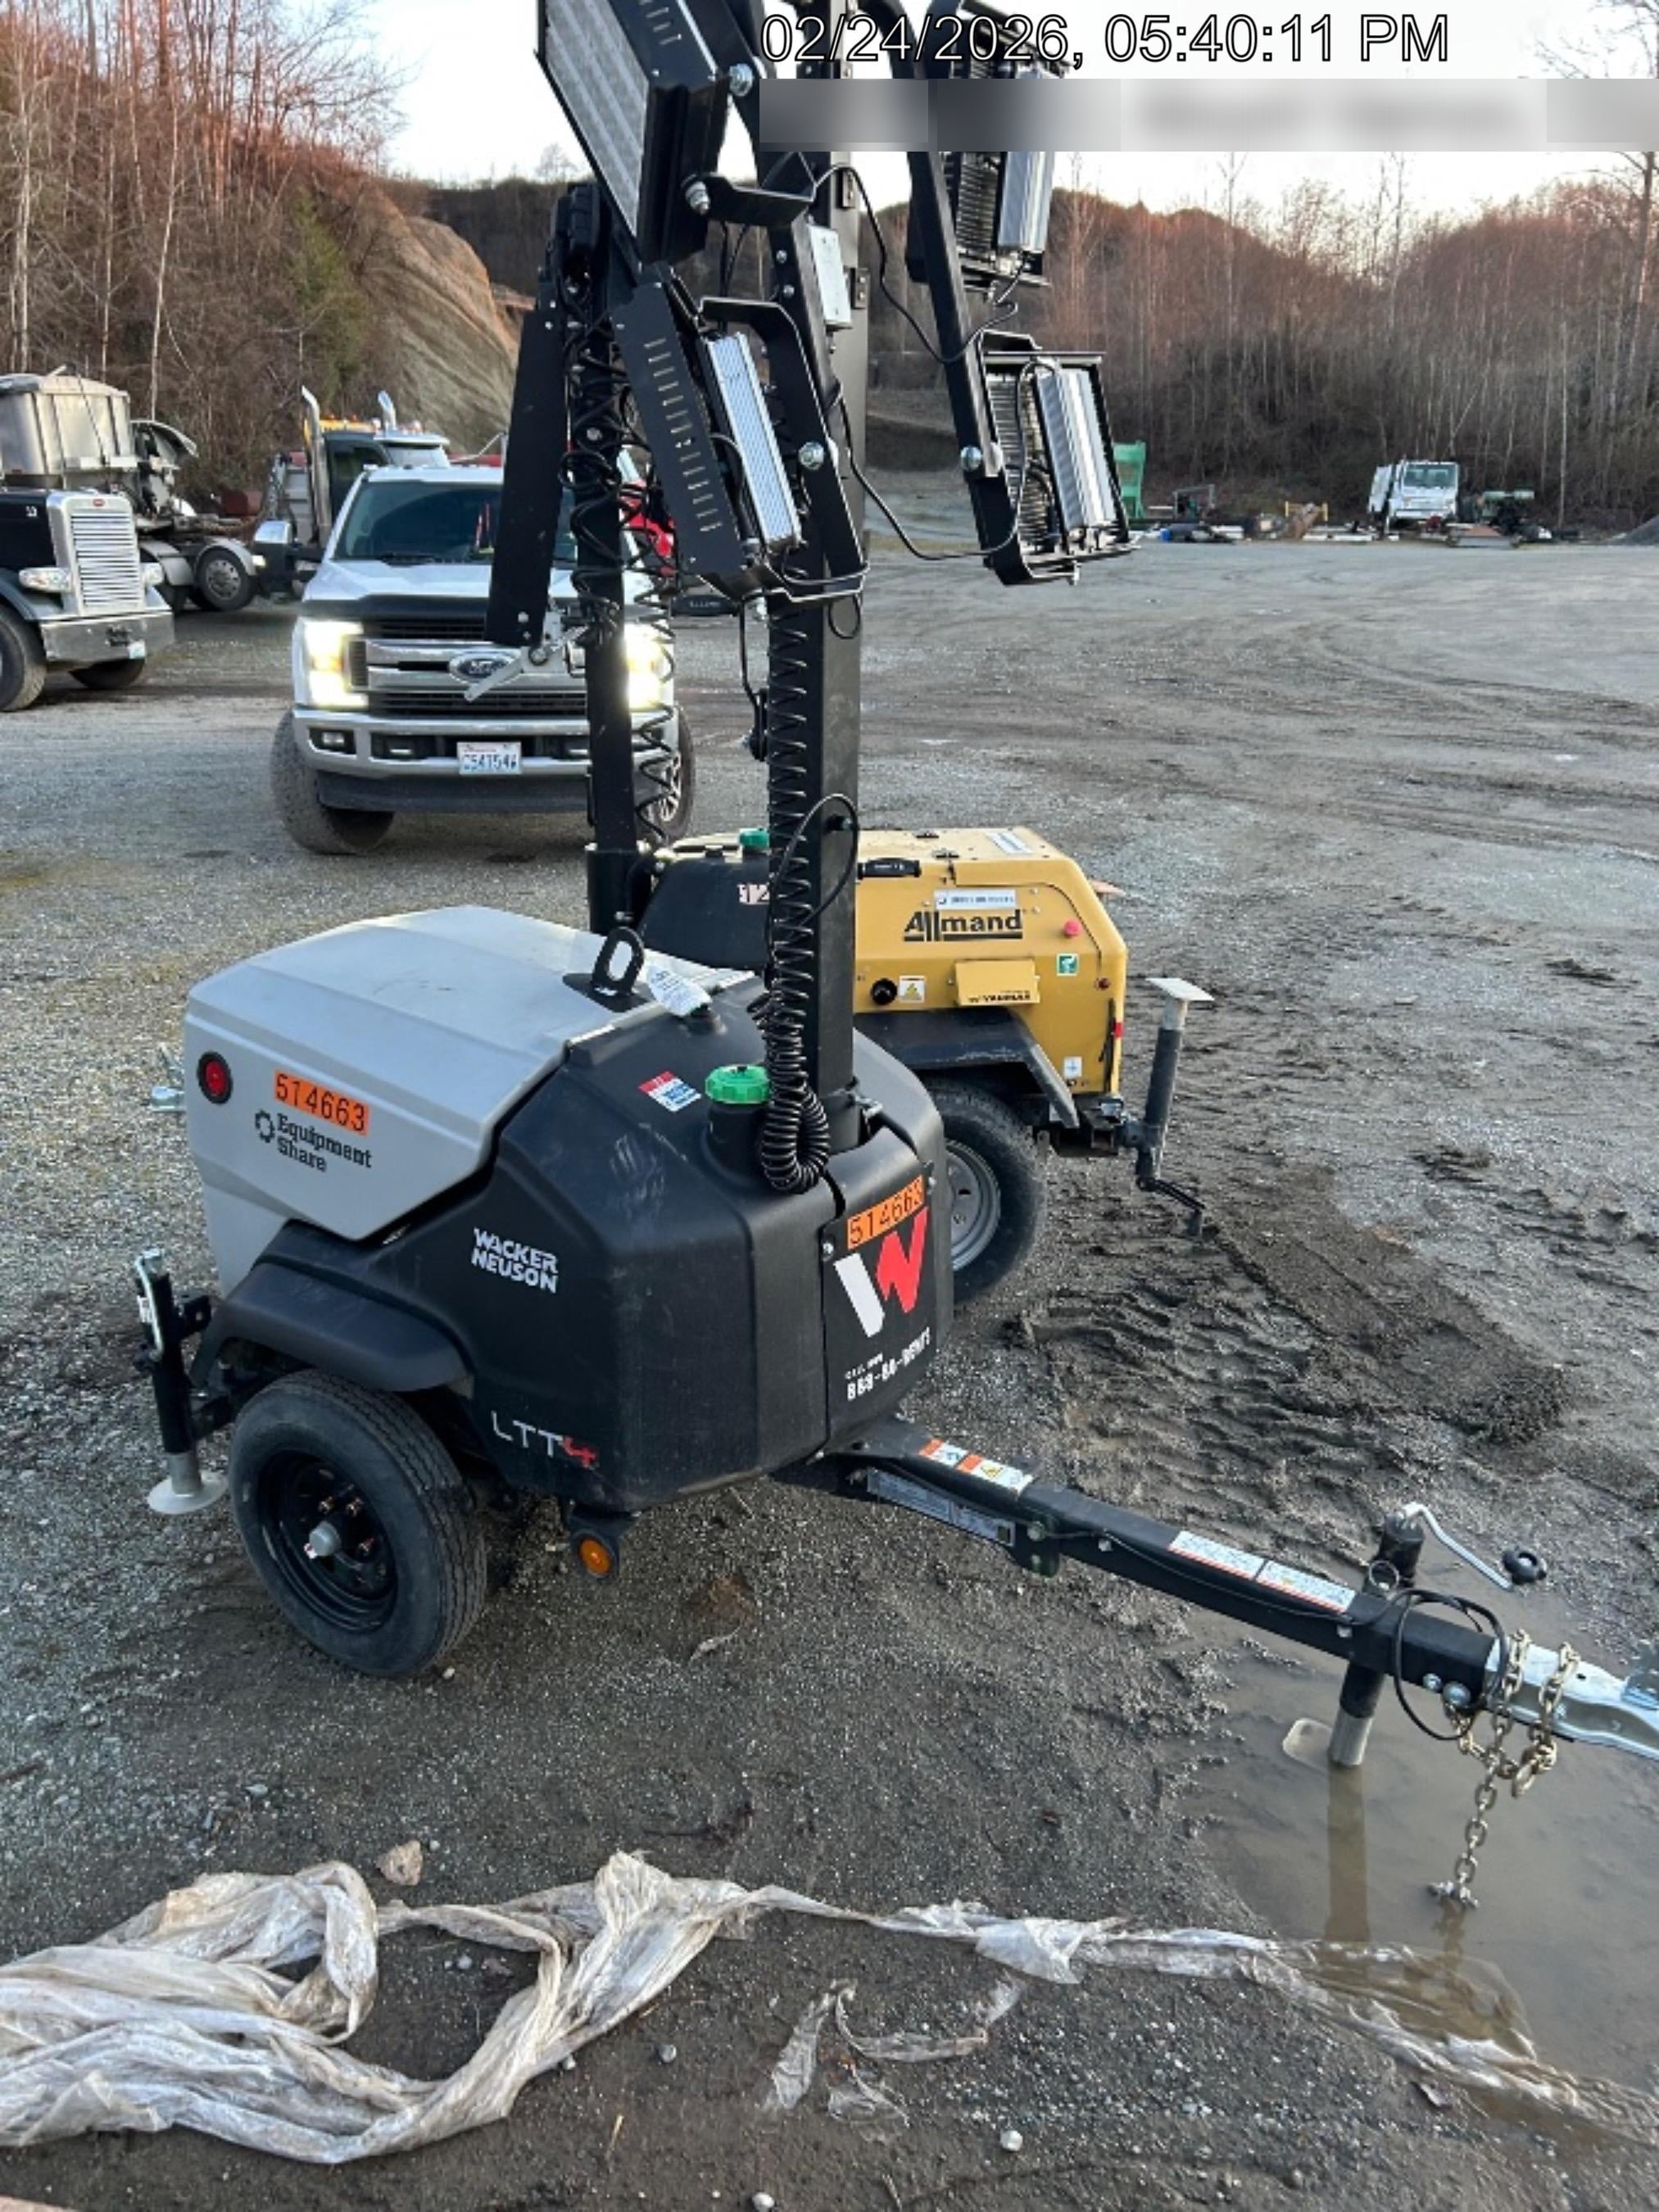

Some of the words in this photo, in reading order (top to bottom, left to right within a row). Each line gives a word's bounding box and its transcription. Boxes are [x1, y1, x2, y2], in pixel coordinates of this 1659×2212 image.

[904, 910, 1022, 942] Allmand
[276, 1073, 365, 1131] 514663
[277, 1113, 372, 1168] Equipment
[277, 1135, 327, 1172] Share
[471, 1247, 558, 1294] NEUSON
[474, 1226, 558, 1274] WACKER
[492, 1410, 596, 1469] LTT4
